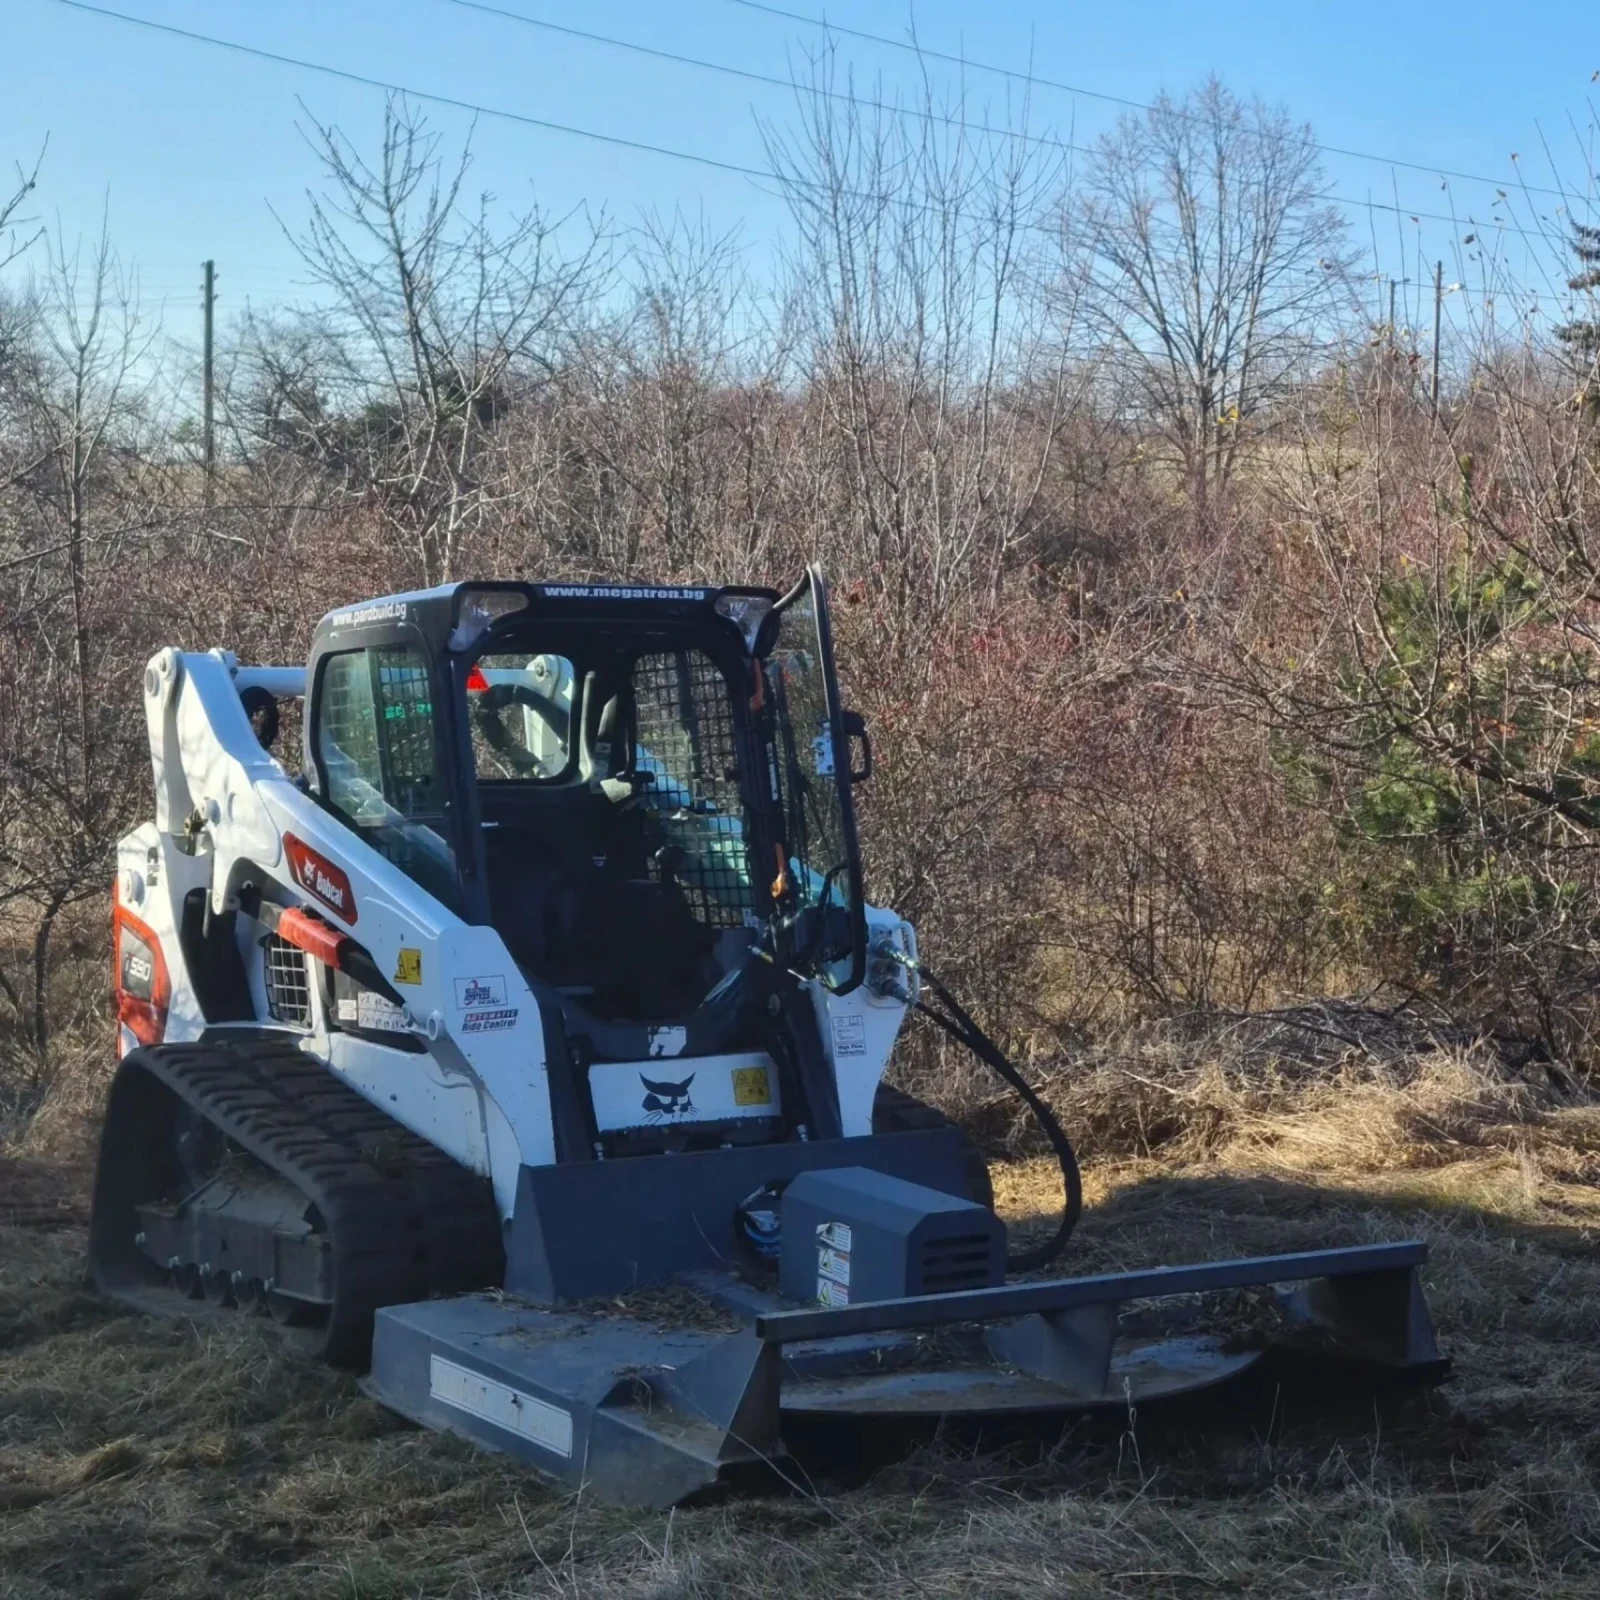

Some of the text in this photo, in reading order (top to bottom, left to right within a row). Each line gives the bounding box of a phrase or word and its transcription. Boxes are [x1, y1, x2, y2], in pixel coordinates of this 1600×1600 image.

[544, 587, 705, 600] www.megatron.bg
[316, 869, 343, 909] Bobcat
[483, 1018, 517, 1030] Control
